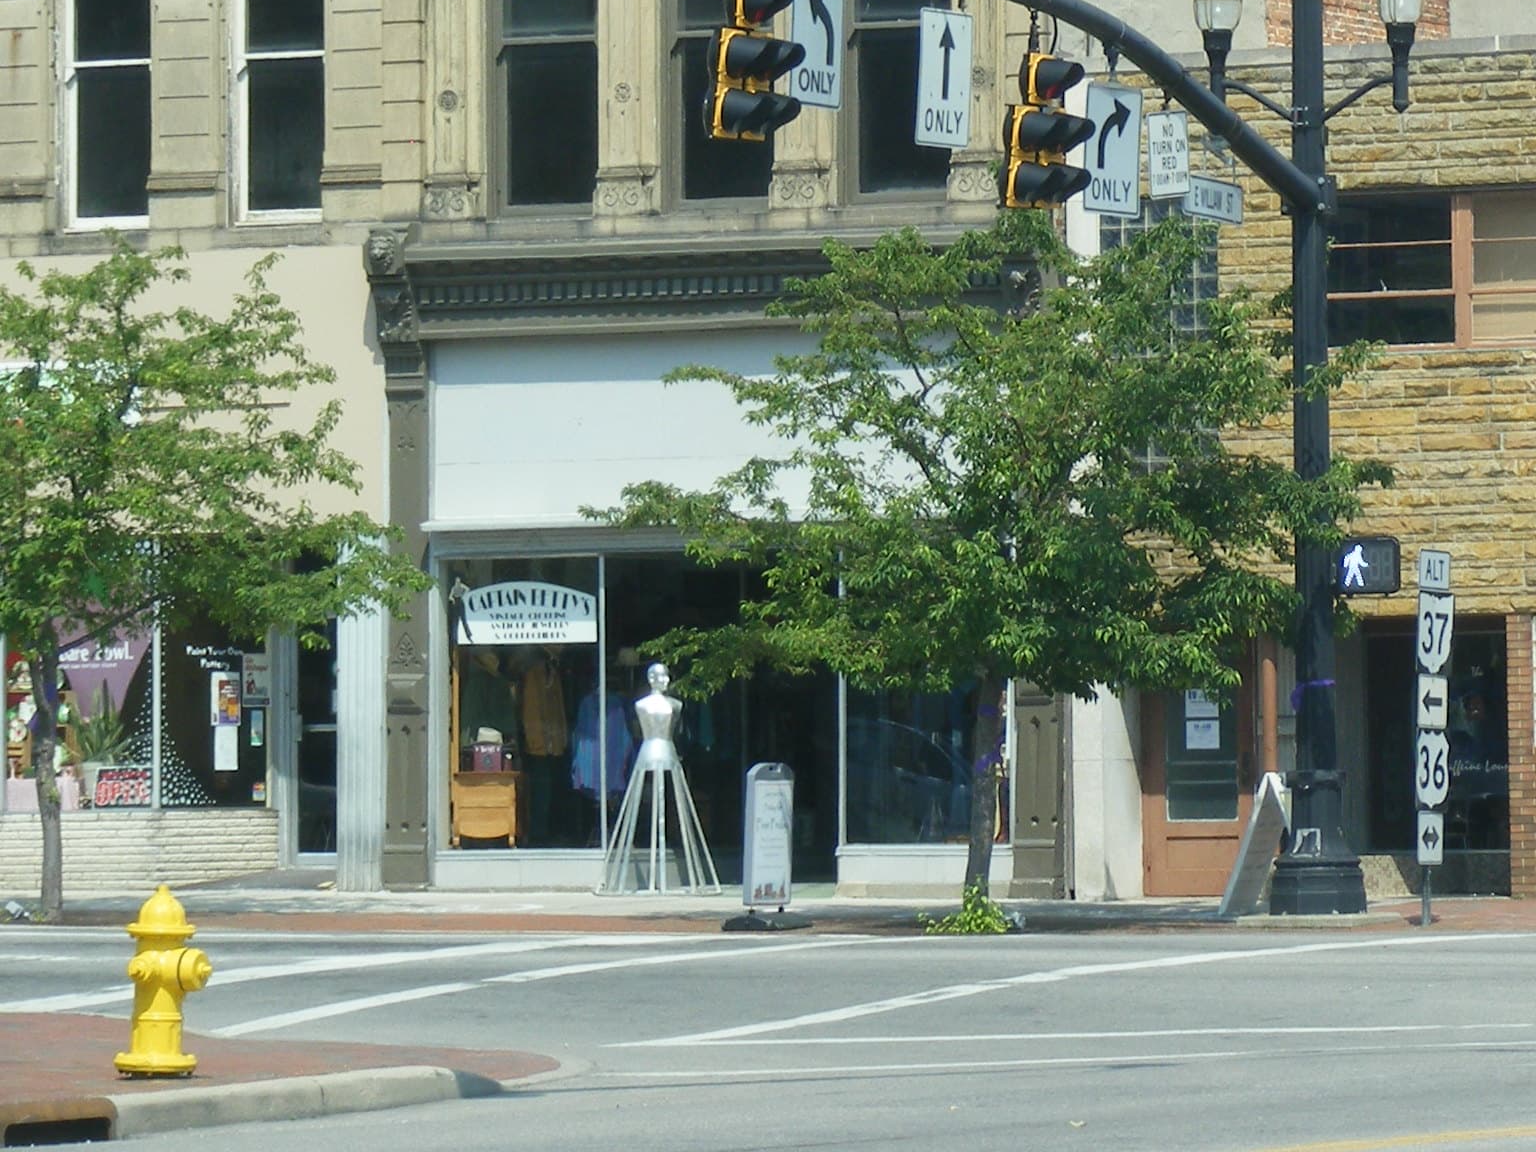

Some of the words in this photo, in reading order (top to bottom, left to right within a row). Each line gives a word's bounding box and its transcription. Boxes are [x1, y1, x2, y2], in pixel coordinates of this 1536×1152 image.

[798, 68, 836, 95] ONLY
[925, 108, 964, 134] ONLY
[1162, 123, 1174, 137] NO
[1152, 140, 1172, 155] TURN
[1175, 138, 1186, 153] ON
[1162, 156, 1177, 170] RED
[1092, 177, 1131, 202] ONLY
[1227, 192, 1234, 213] ST
[1425, 559, 1445, 582] ALT
[469, 589, 526, 612] CAPTAIN
[1422, 611, 1449, 655] 37
[1419, 745, 1445, 790] 36
